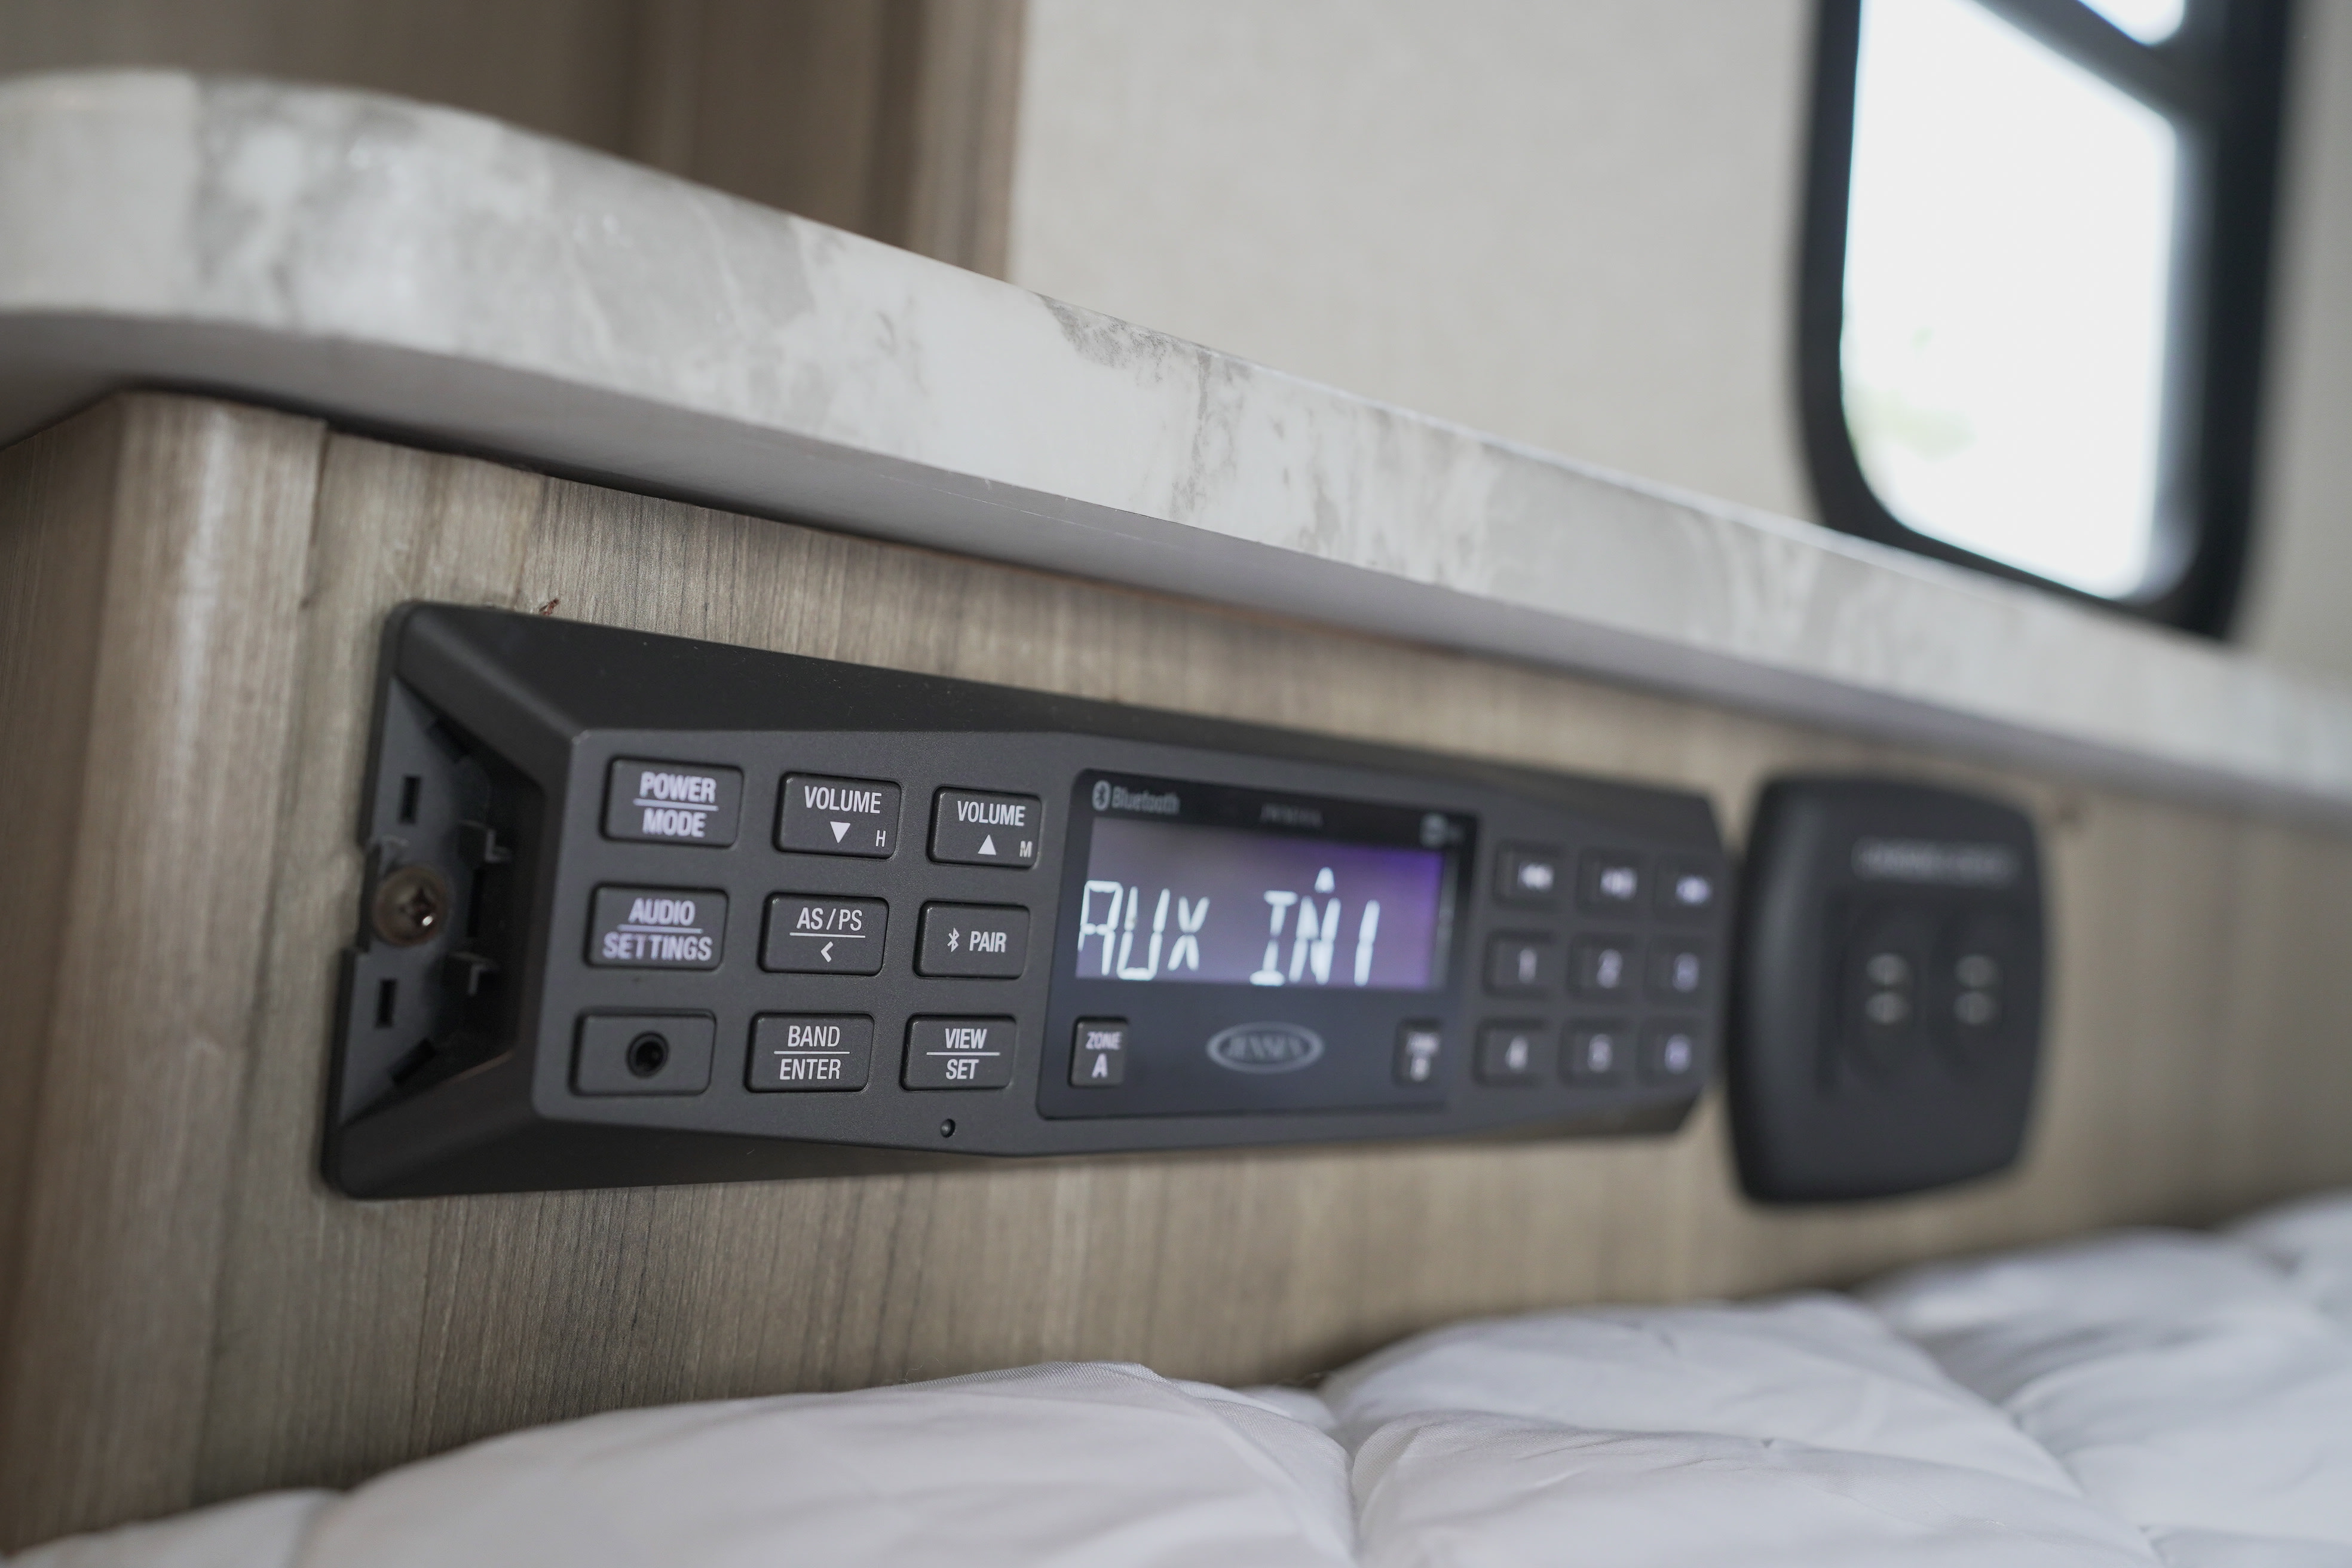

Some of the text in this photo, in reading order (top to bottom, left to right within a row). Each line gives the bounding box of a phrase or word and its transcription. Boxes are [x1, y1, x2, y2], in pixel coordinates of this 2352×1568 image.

[639, 771, 717, 803] POWER
[804, 786, 882, 814] VOLUME
[1110, 786, 1180, 815] Bluetooth
[642, 808, 708, 838] MODE
[957, 801, 1026, 826] VOLUME
[875, 830, 886, 847] H
[1019, 841, 1033, 858] M
[628, 898, 695, 926] AUDIO
[969, 931, 1007, 953] PAIR
[1077, 880, 1210, 981] AUX
[602, 932, 713, 960] SETTINGS
[788, 1025, 840, 1047] BAND
[945, 1028, 987, 1049] VIEW
[1085, 1031, 1122, 1051] ZONE
[779, 1058, 841, 1080] ENTER
[945, 1058, 979, 1080] SET
[1092, 1054, 1108, 1078] A
